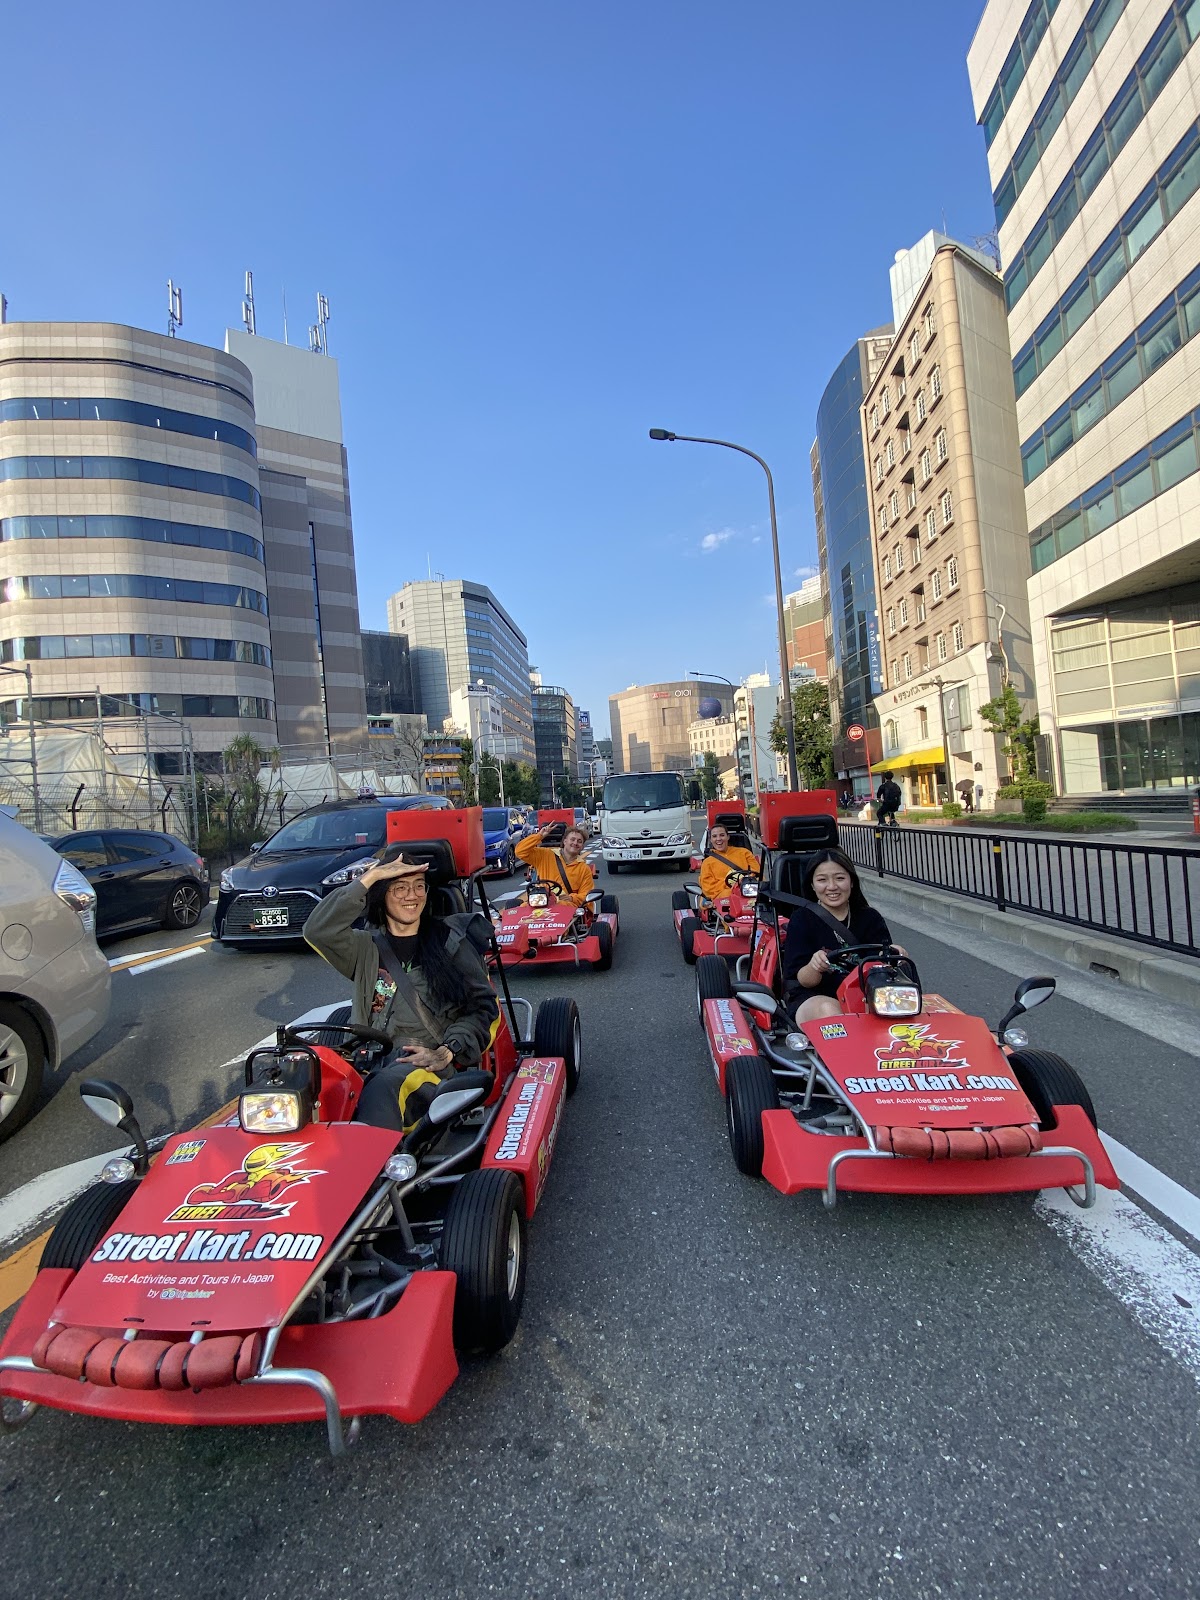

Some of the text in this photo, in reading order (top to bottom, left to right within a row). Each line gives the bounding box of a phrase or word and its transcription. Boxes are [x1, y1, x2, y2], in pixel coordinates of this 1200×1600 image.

[262, 915, 287, 925] 85-95
[844, 1076, 915, 1094] Street
[981, 1096, 1006, 1104] Japan
[92, 1231, 188, 1262] Street
[102, 1273, 274, 1285] Best Activities and Tours in Japan
[147, 1289, 160, 1299] by
